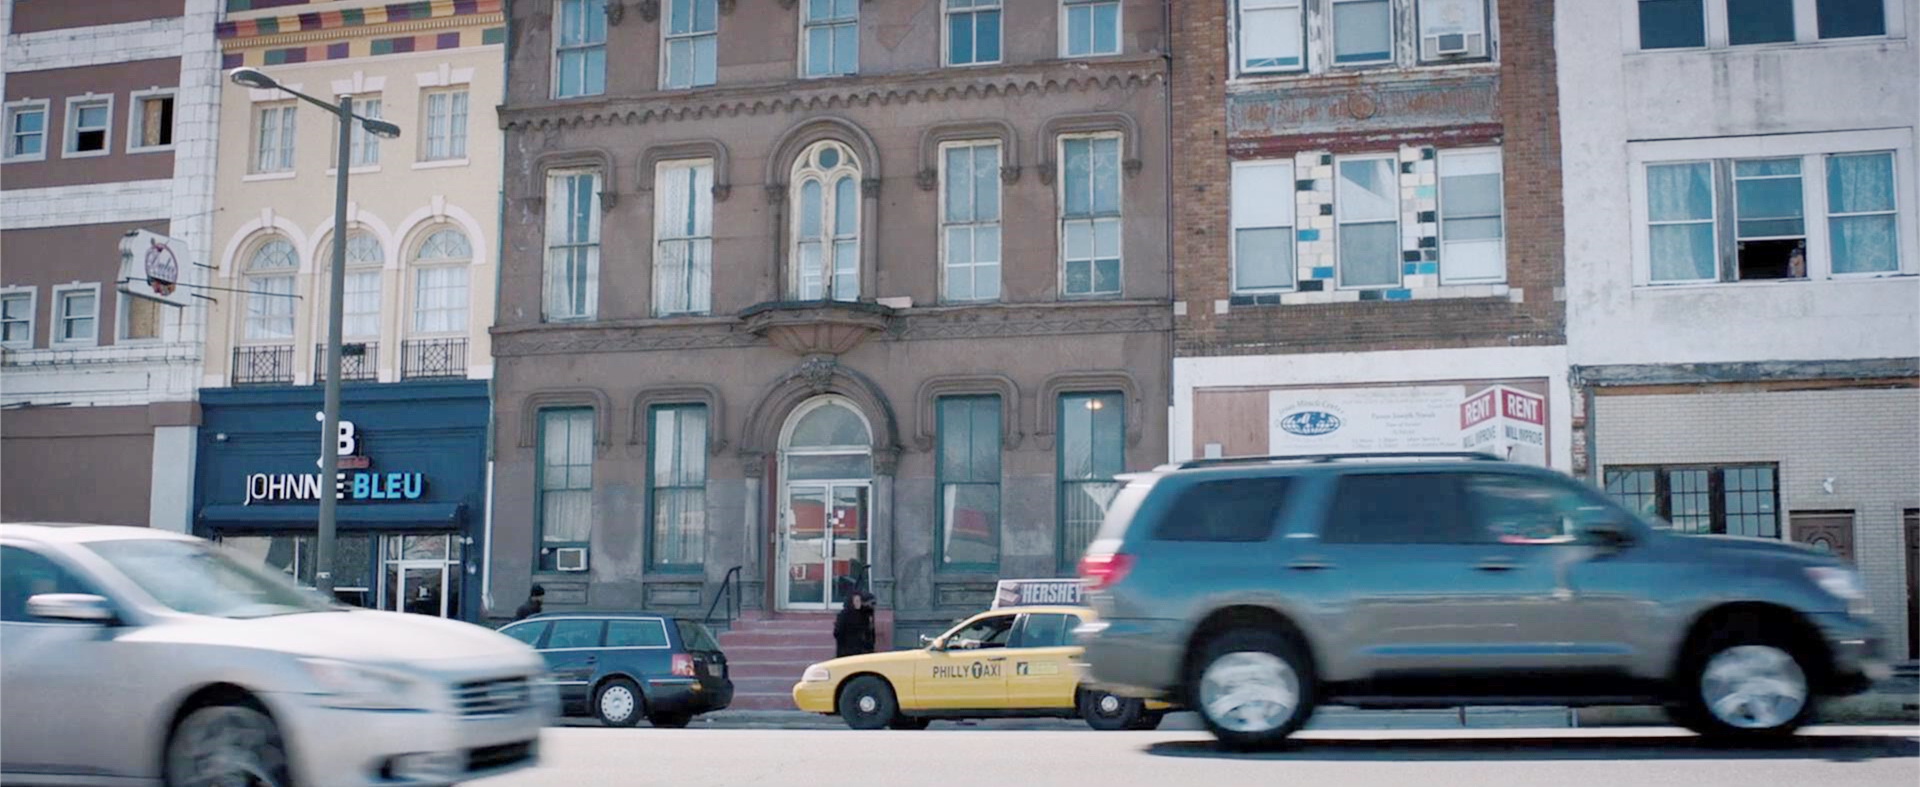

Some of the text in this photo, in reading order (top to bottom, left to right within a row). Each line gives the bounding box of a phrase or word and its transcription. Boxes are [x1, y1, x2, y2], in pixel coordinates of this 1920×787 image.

[1465, 395, 1491, 425] RENT
[1507, 393, 1538, 421] RENT
[243, 473, 422, 506] JOHNNE BLEU
[933, 661, 1001, 679] PHILLY TAXI
